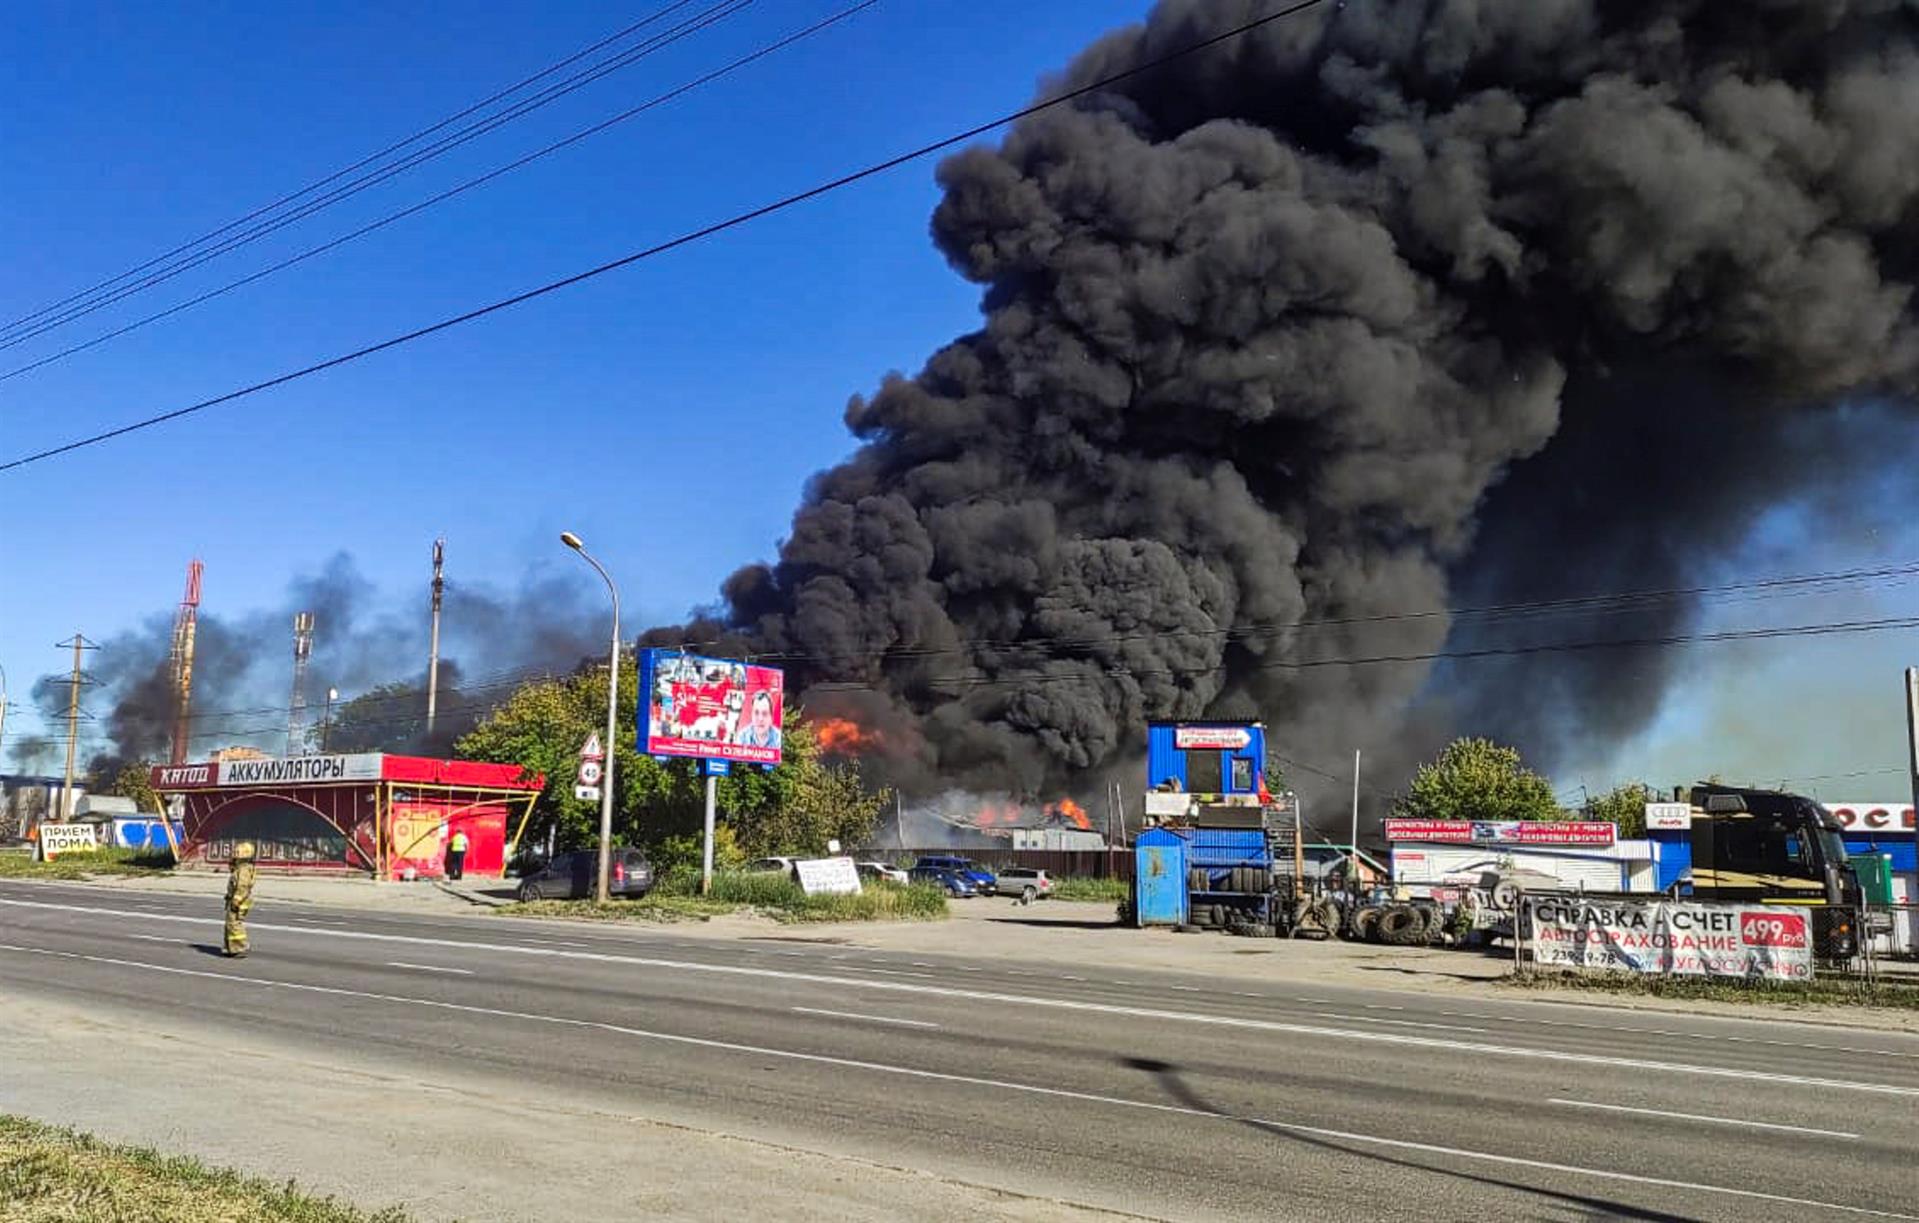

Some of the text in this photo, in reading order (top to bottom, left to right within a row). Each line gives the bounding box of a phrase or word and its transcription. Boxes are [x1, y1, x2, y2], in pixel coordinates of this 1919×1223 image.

[160, 767, 210, 786] КАТОД
[228, 758, 345, 782] АККУМУЛЯТОРЫ
[584, 768, 597, 778] 40
[44, 826, 91, 837] ПРИЕМ
[48, 838, 93, 849] ЛОМА
[1536, 904, 1648, 929] СПРАВКА
[1672, 911, 1735, 931] СЧЕТ
[1540, 926, 1737, 951] АВТОСТРАХОВАНИЕ
[1743, 919, 1784, 941] 499
[1551, 948, 1617, 964] 239-9-78
[1656, 954, 1808, 977] КРУГЛОСУОЧНО
